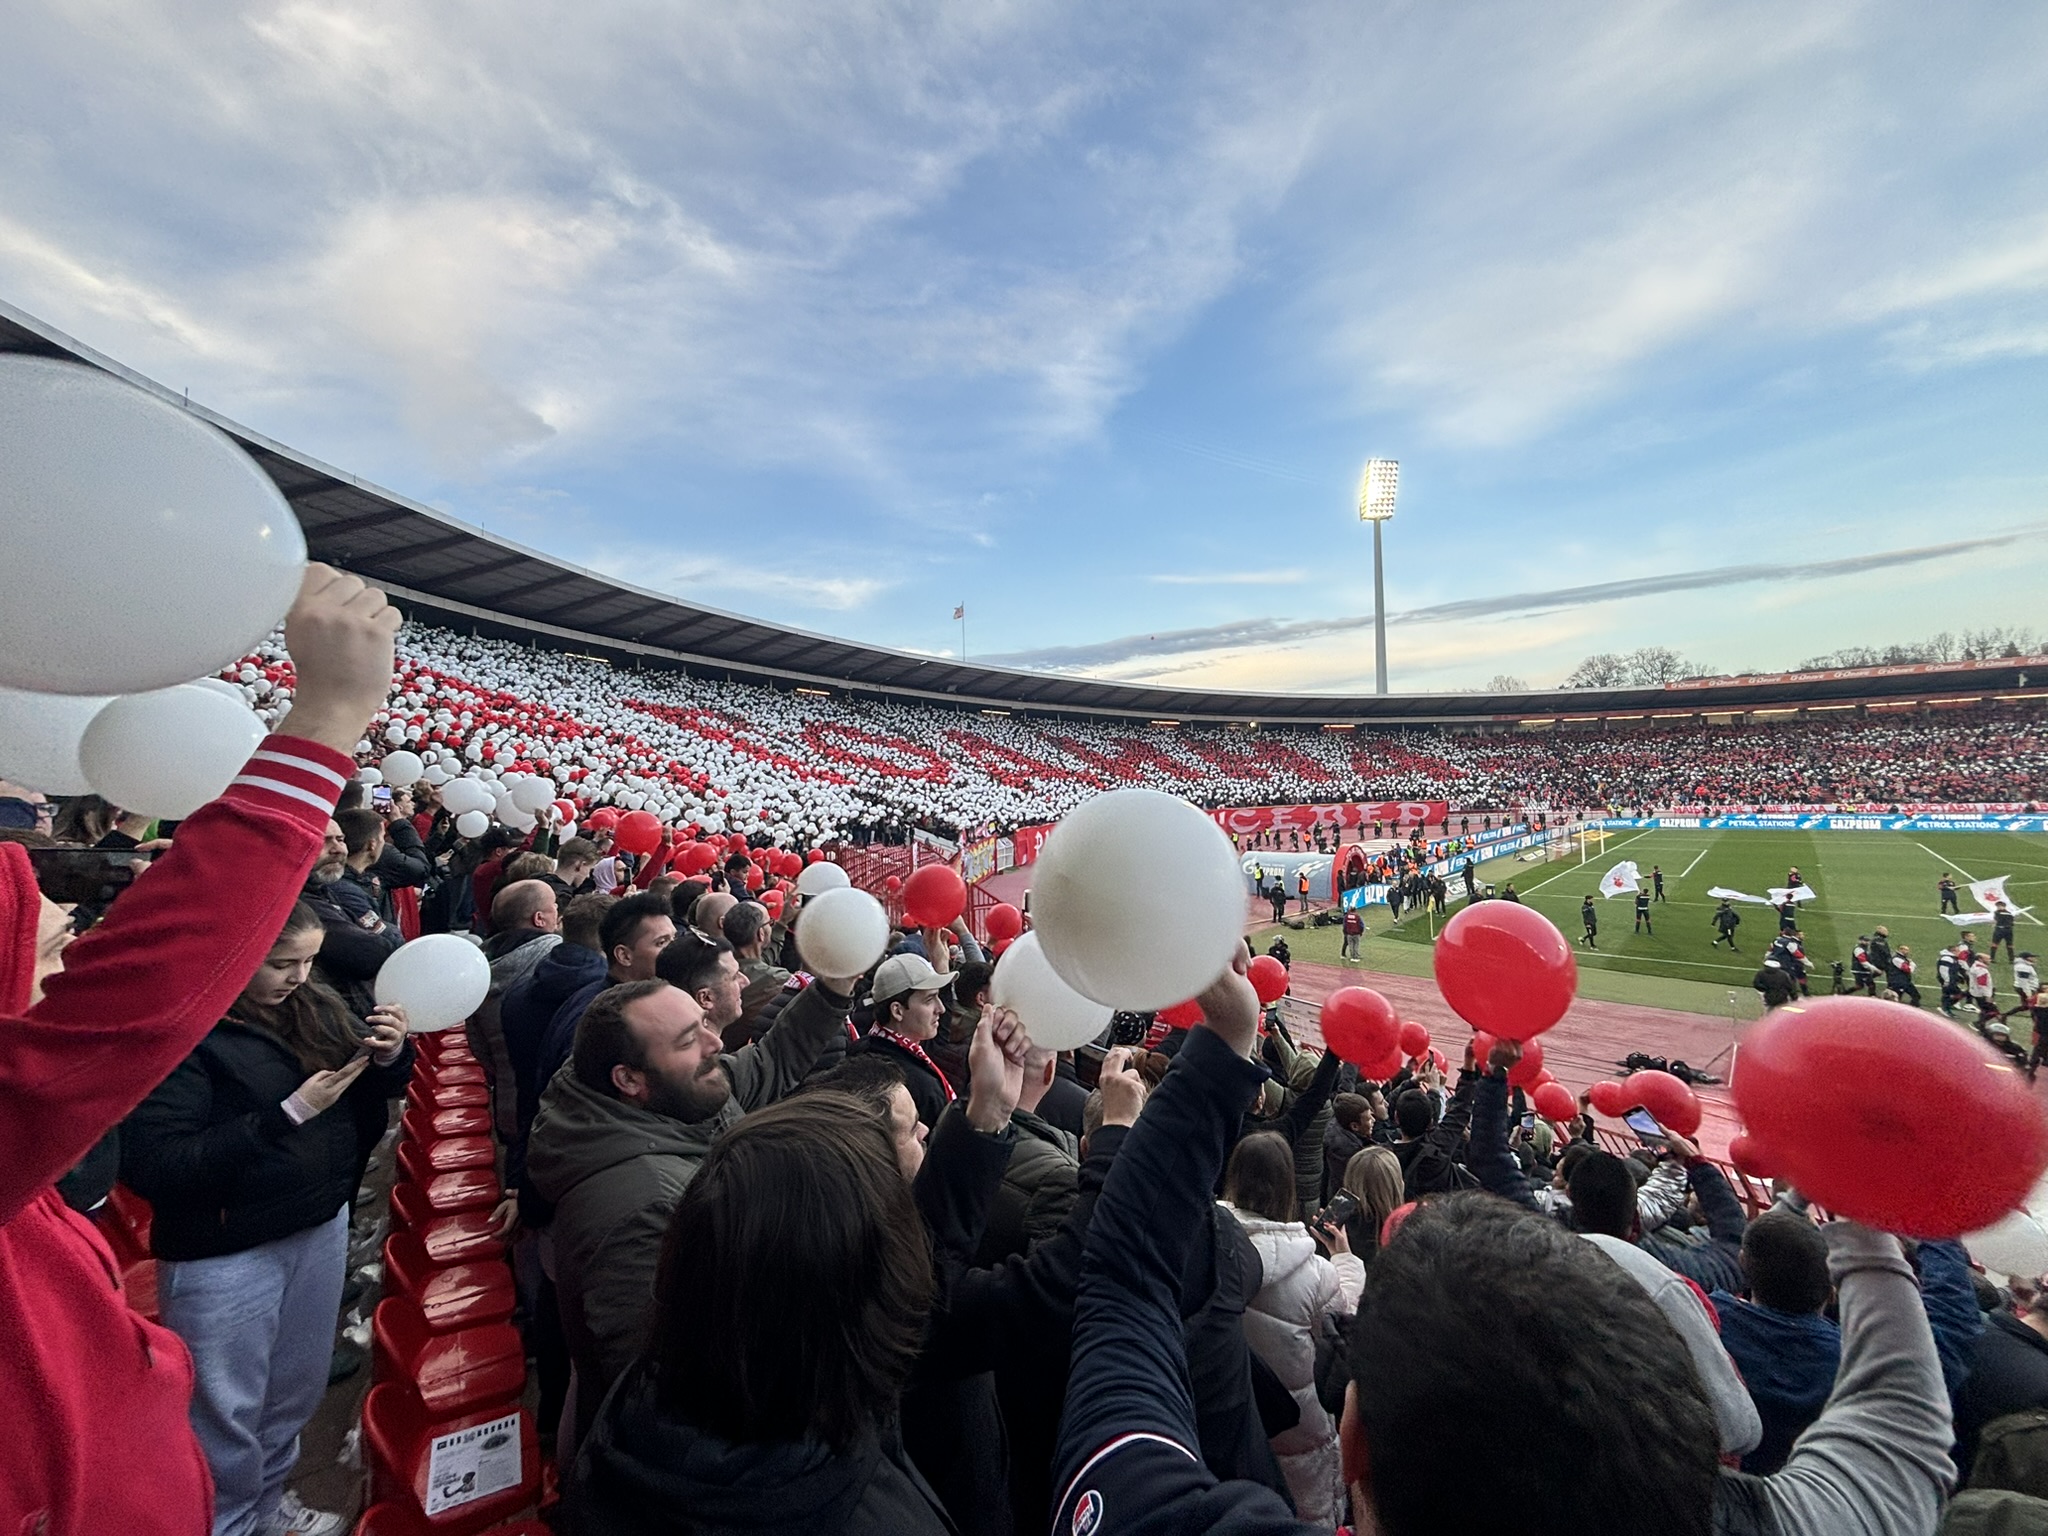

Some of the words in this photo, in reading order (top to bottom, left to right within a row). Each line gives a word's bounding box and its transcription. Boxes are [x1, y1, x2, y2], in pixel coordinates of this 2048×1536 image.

[1659, 818, 1700, 828] GAZPROM
[1830, 819, 1882, 830] GAZPROM
[1916, 821, 1953, 829] PETROL
[1954, 821, 2001, 829] STATIONS
